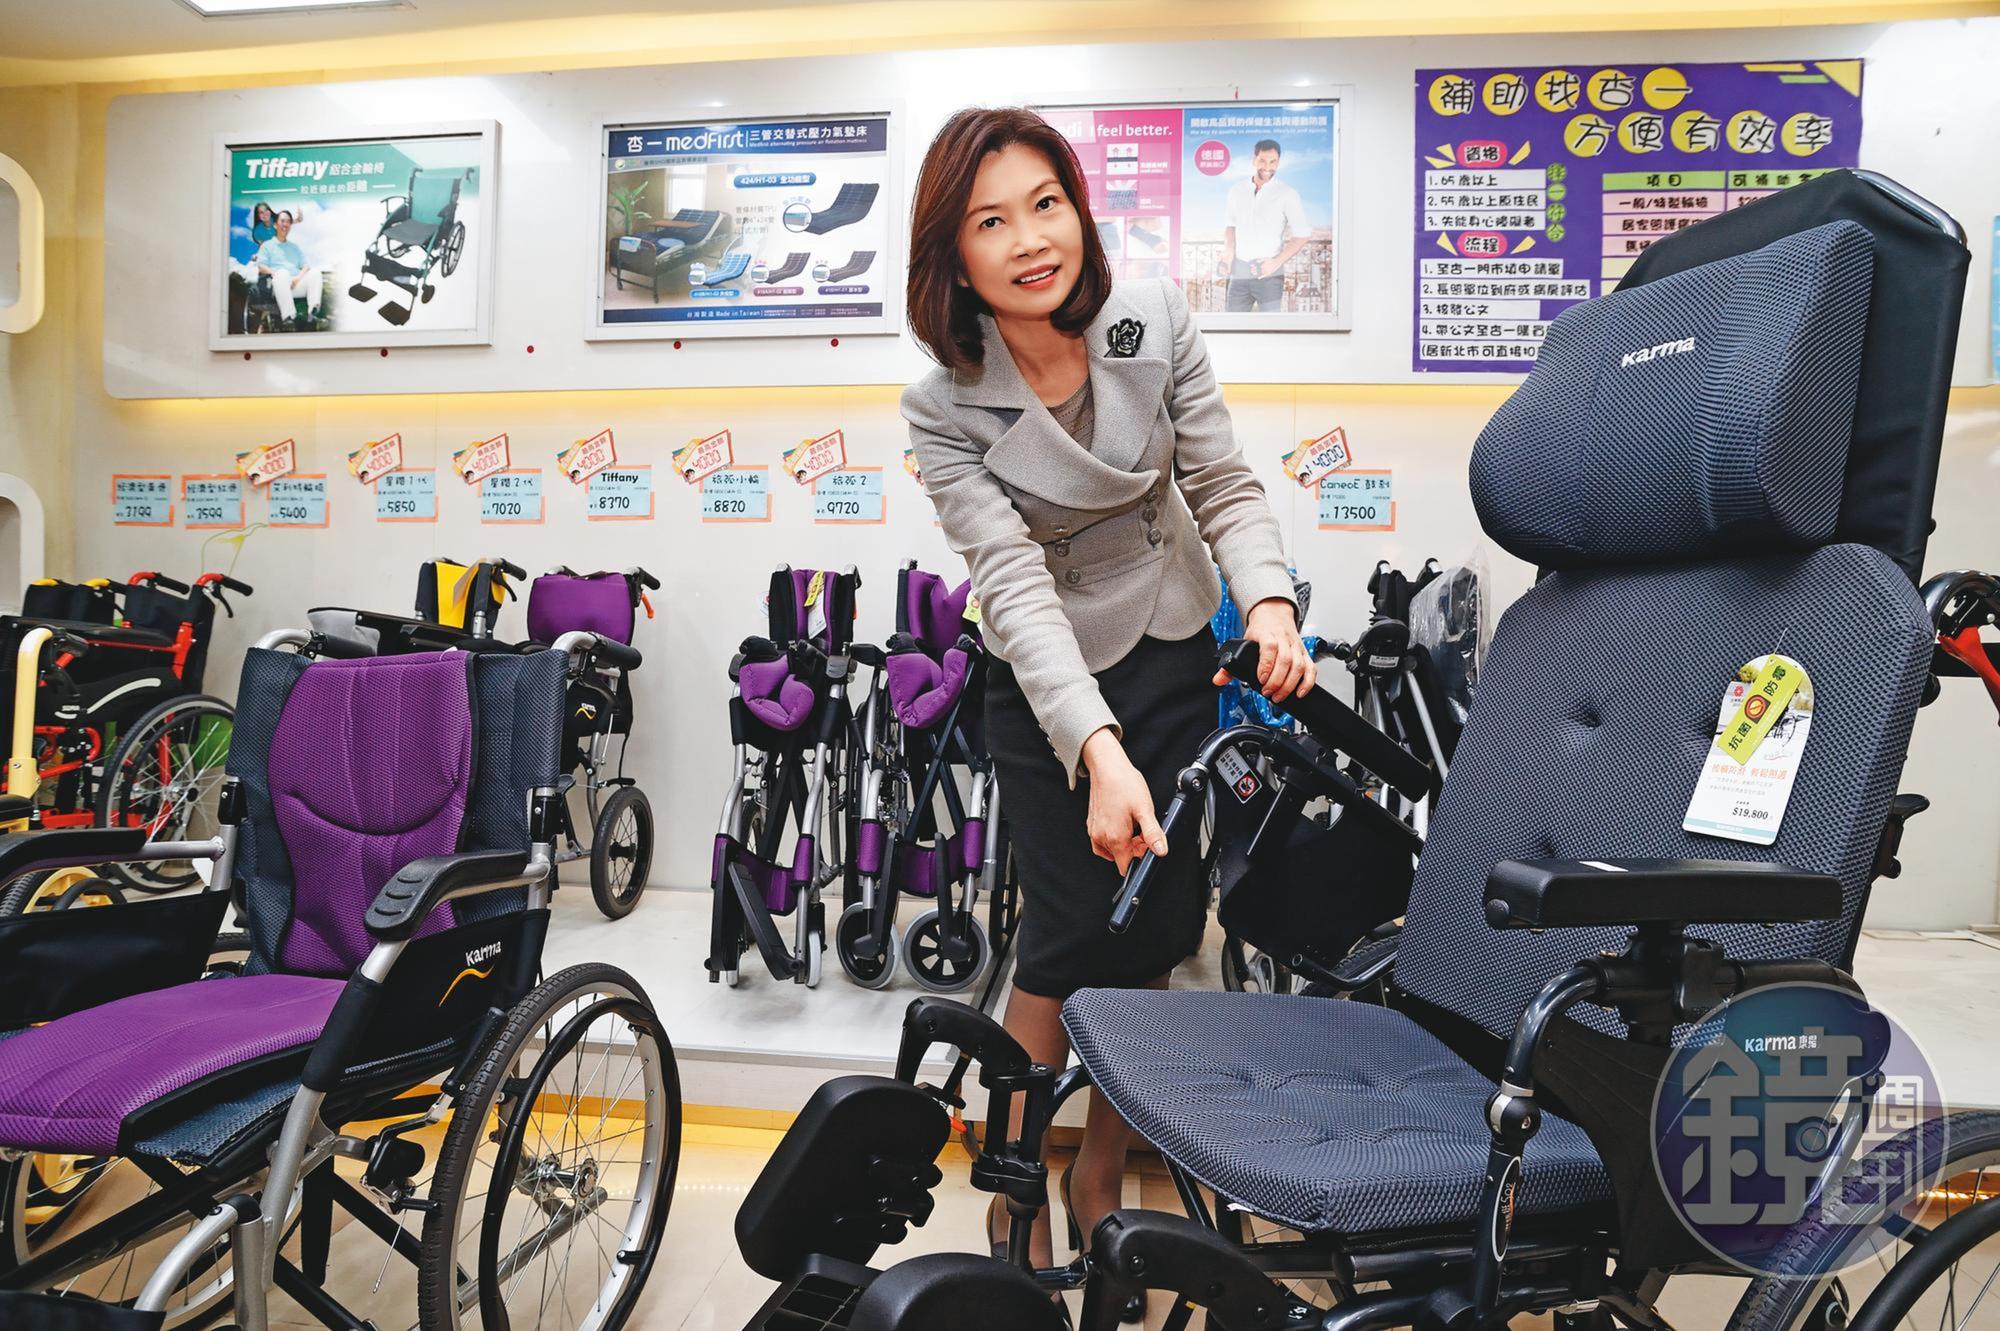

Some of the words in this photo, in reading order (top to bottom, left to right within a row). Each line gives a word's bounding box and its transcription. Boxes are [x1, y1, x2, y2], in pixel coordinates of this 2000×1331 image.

[1439, 73, 1690, 113] 補助找杏一
[750, 126, 867, 141] 三管交替式壓力氣墊床
[1097, 124, 1122, 137] feel
[1126, 122, 1173, 136] better.
[1575, 114, 1832, 152] 方便有效率
[1465, 146, 1499, 162] 資格
[246, 158, 329, 180] Tiffany
[1647, 174, 1682, 187] 項目
[1733, 172, 1826, 187] 可補助金
[1465, 236, 1498, 253] 流程
[1421, 324, 1550, 337] 4.帶公文至杏一購買
[1421, 344, 1541, 358] (居新北市可直接扣
[601, 472, 639, 484] Tiffany
[387, 500, 416, 513] 5850
[491, 502, 522, 515] 7020
[599, 496, 630, 509] 8370
[714, 500, 746, 513] 8820
[827, 501, 860, 515] 9720
[195, 507, 223, 520] 3599
[280, 506, 307, 519] 5400
[1333, 506, 1376, 520] 13500
